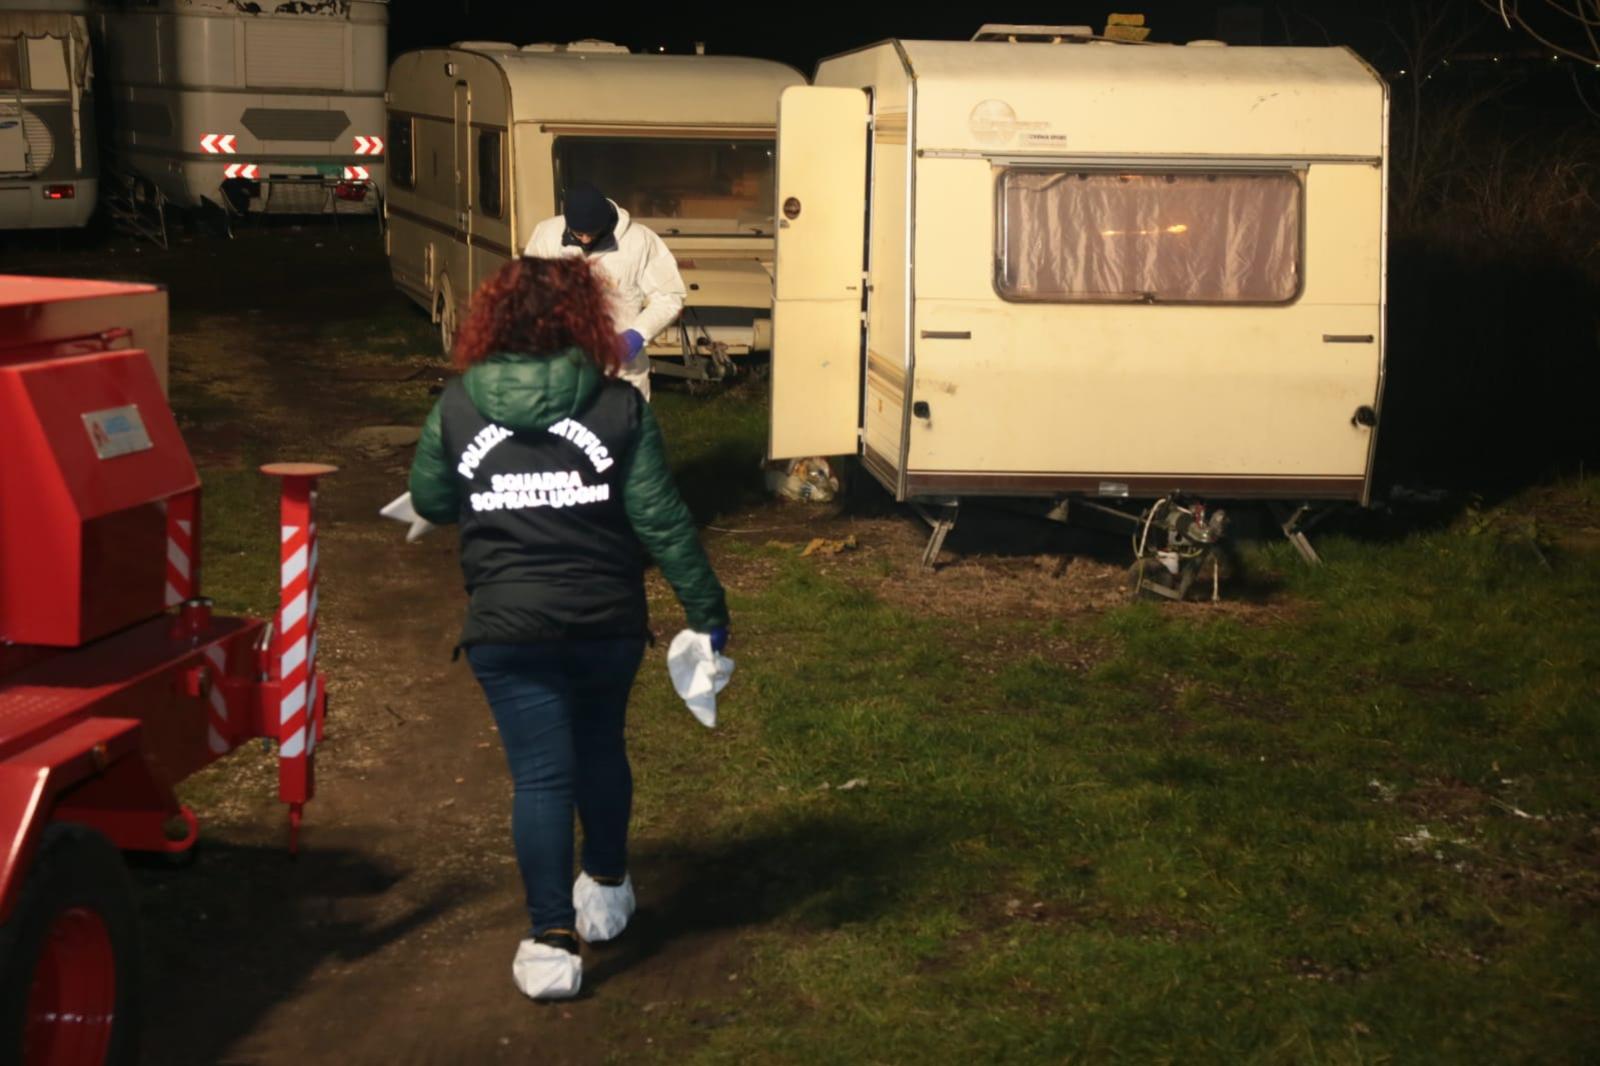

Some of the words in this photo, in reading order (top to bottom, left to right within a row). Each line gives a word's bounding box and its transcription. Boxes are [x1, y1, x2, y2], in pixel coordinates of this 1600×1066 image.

[457, 423, 514, 479] POLIZIA
[491, 471, 583, 493] SQUADRA
[470, 484, 610, 512] SOPRALLUOGHI
